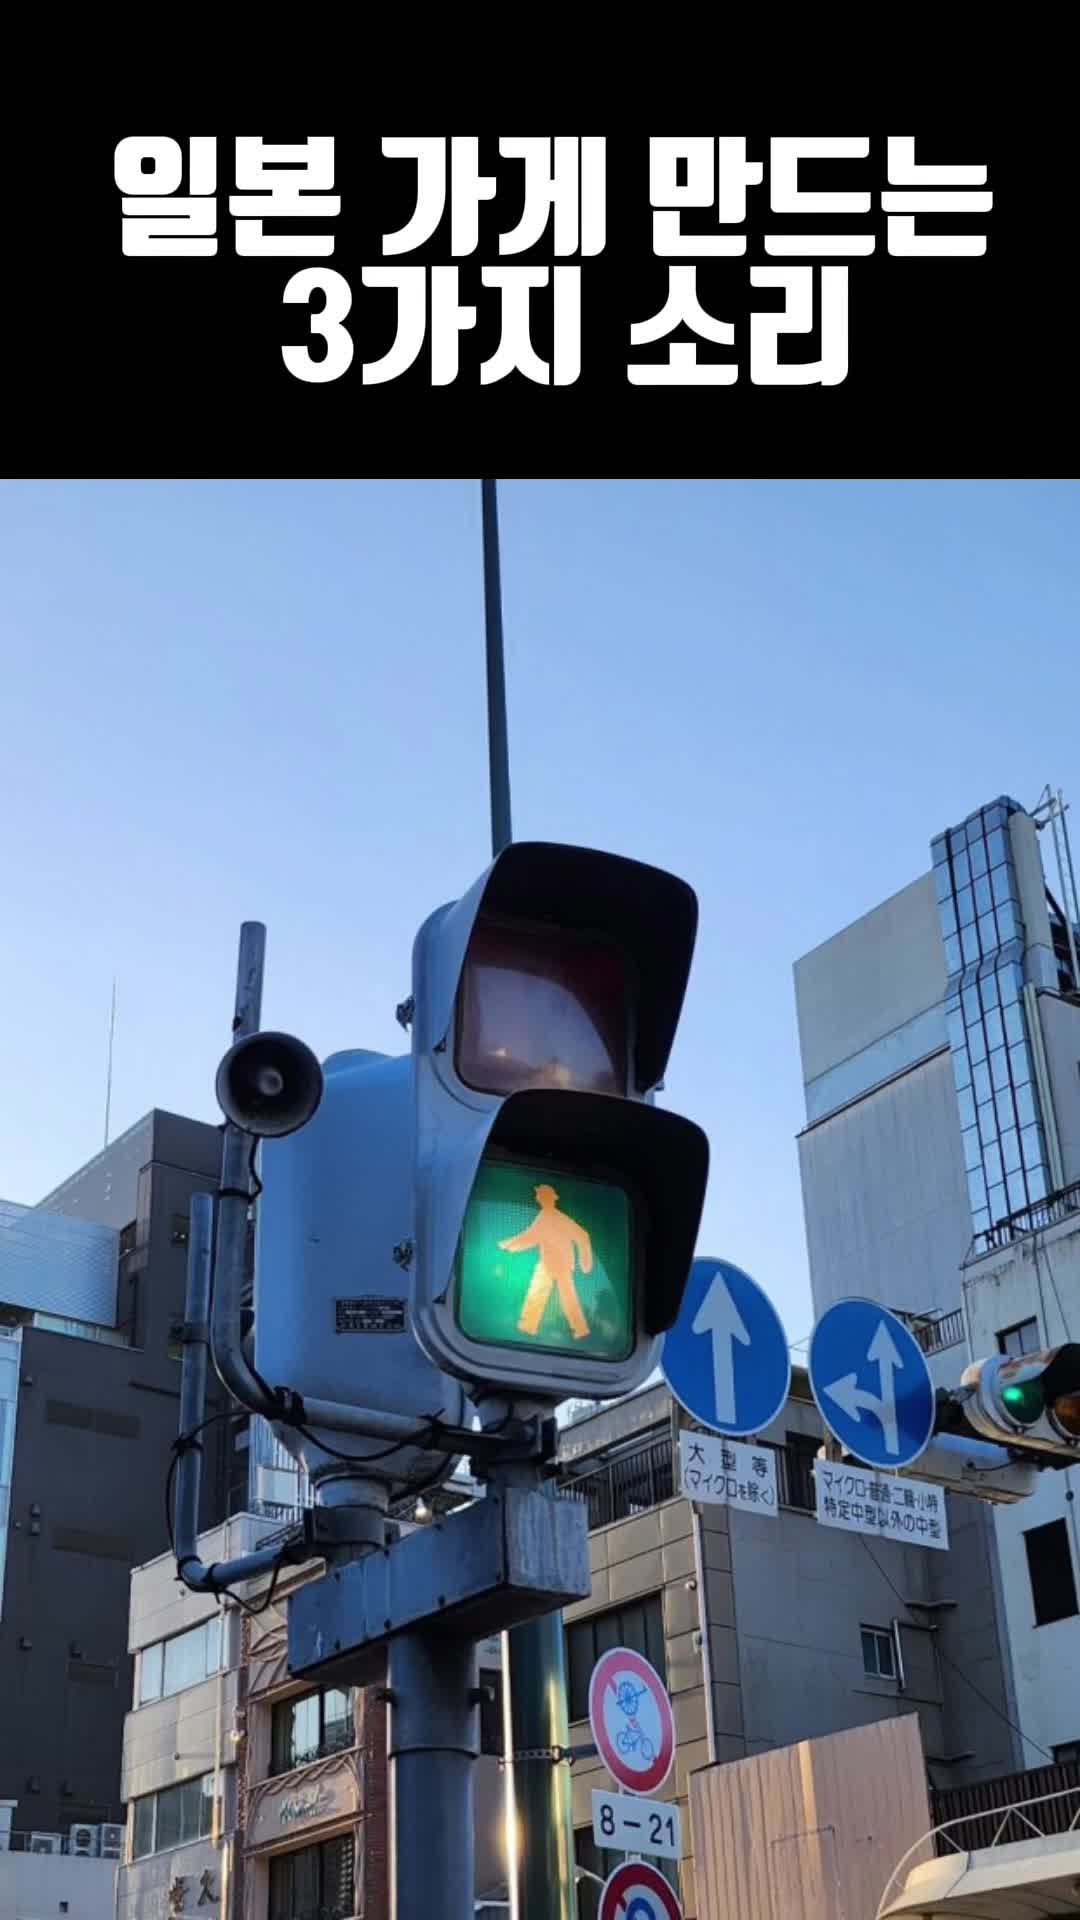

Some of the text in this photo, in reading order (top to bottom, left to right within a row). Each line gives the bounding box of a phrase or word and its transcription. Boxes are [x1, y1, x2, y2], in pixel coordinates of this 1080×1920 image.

[823, 1496, 941, 1539] 特定中型以外の中型
